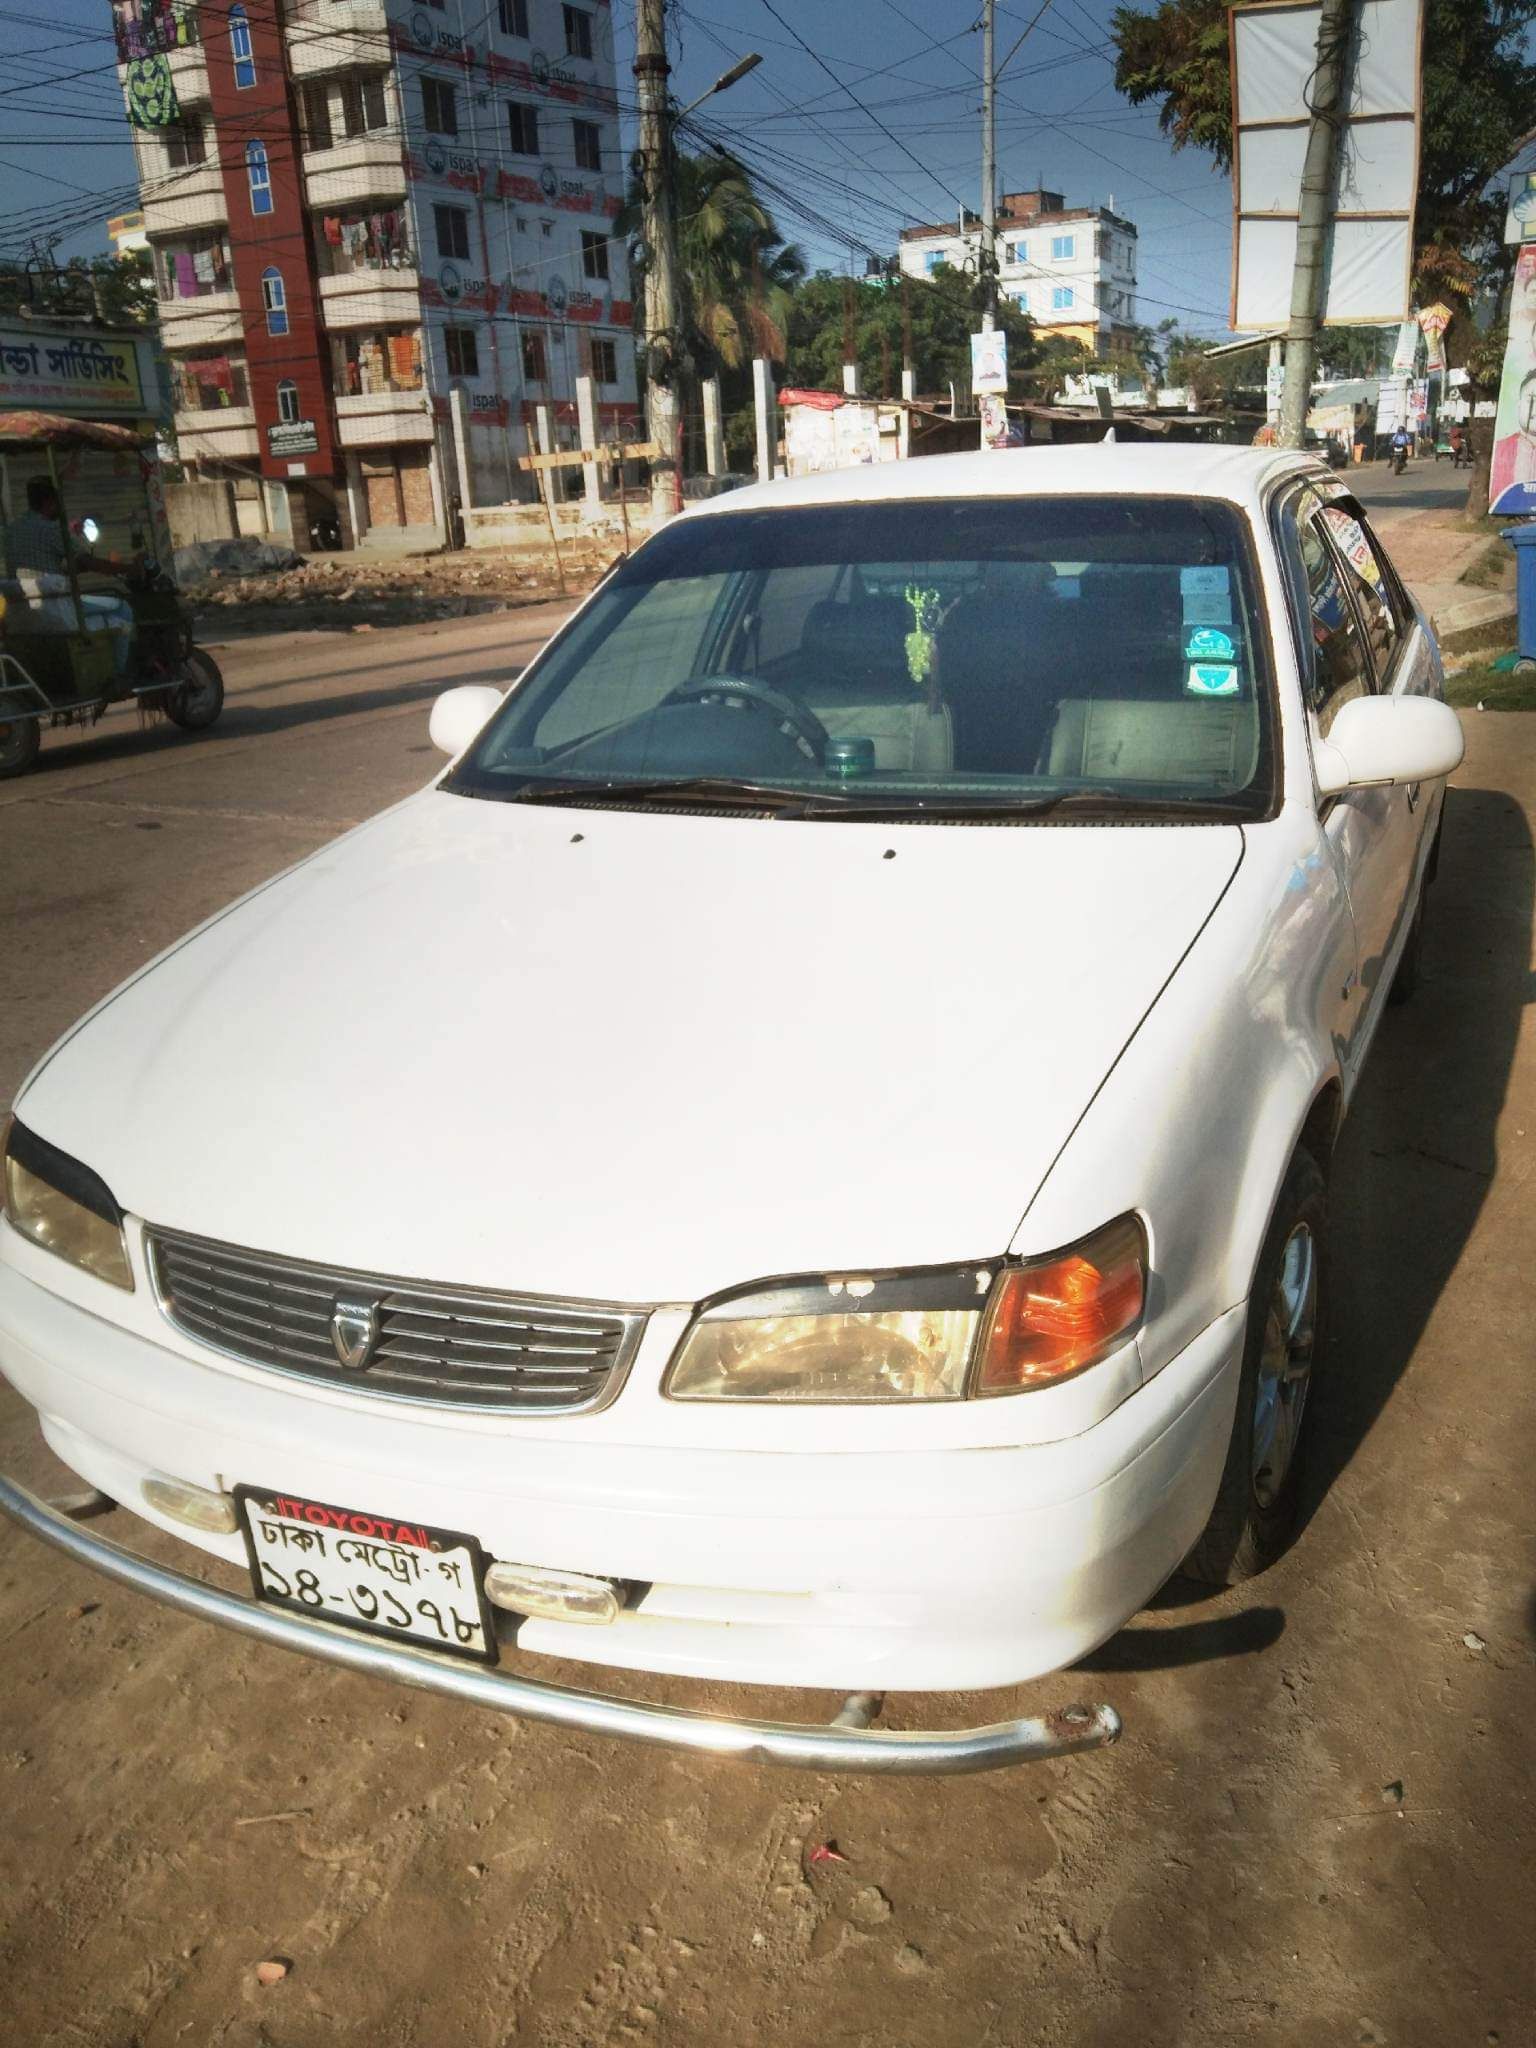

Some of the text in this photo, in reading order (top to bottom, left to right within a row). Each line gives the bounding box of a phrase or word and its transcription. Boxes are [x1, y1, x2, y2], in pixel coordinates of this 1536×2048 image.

[258, 1520, 326, 1557] ঢাকা
[286, 1502, 419, 1545] TOYOTA
[262, 1562, 481, 1643] ১৪-৩১৭৮
